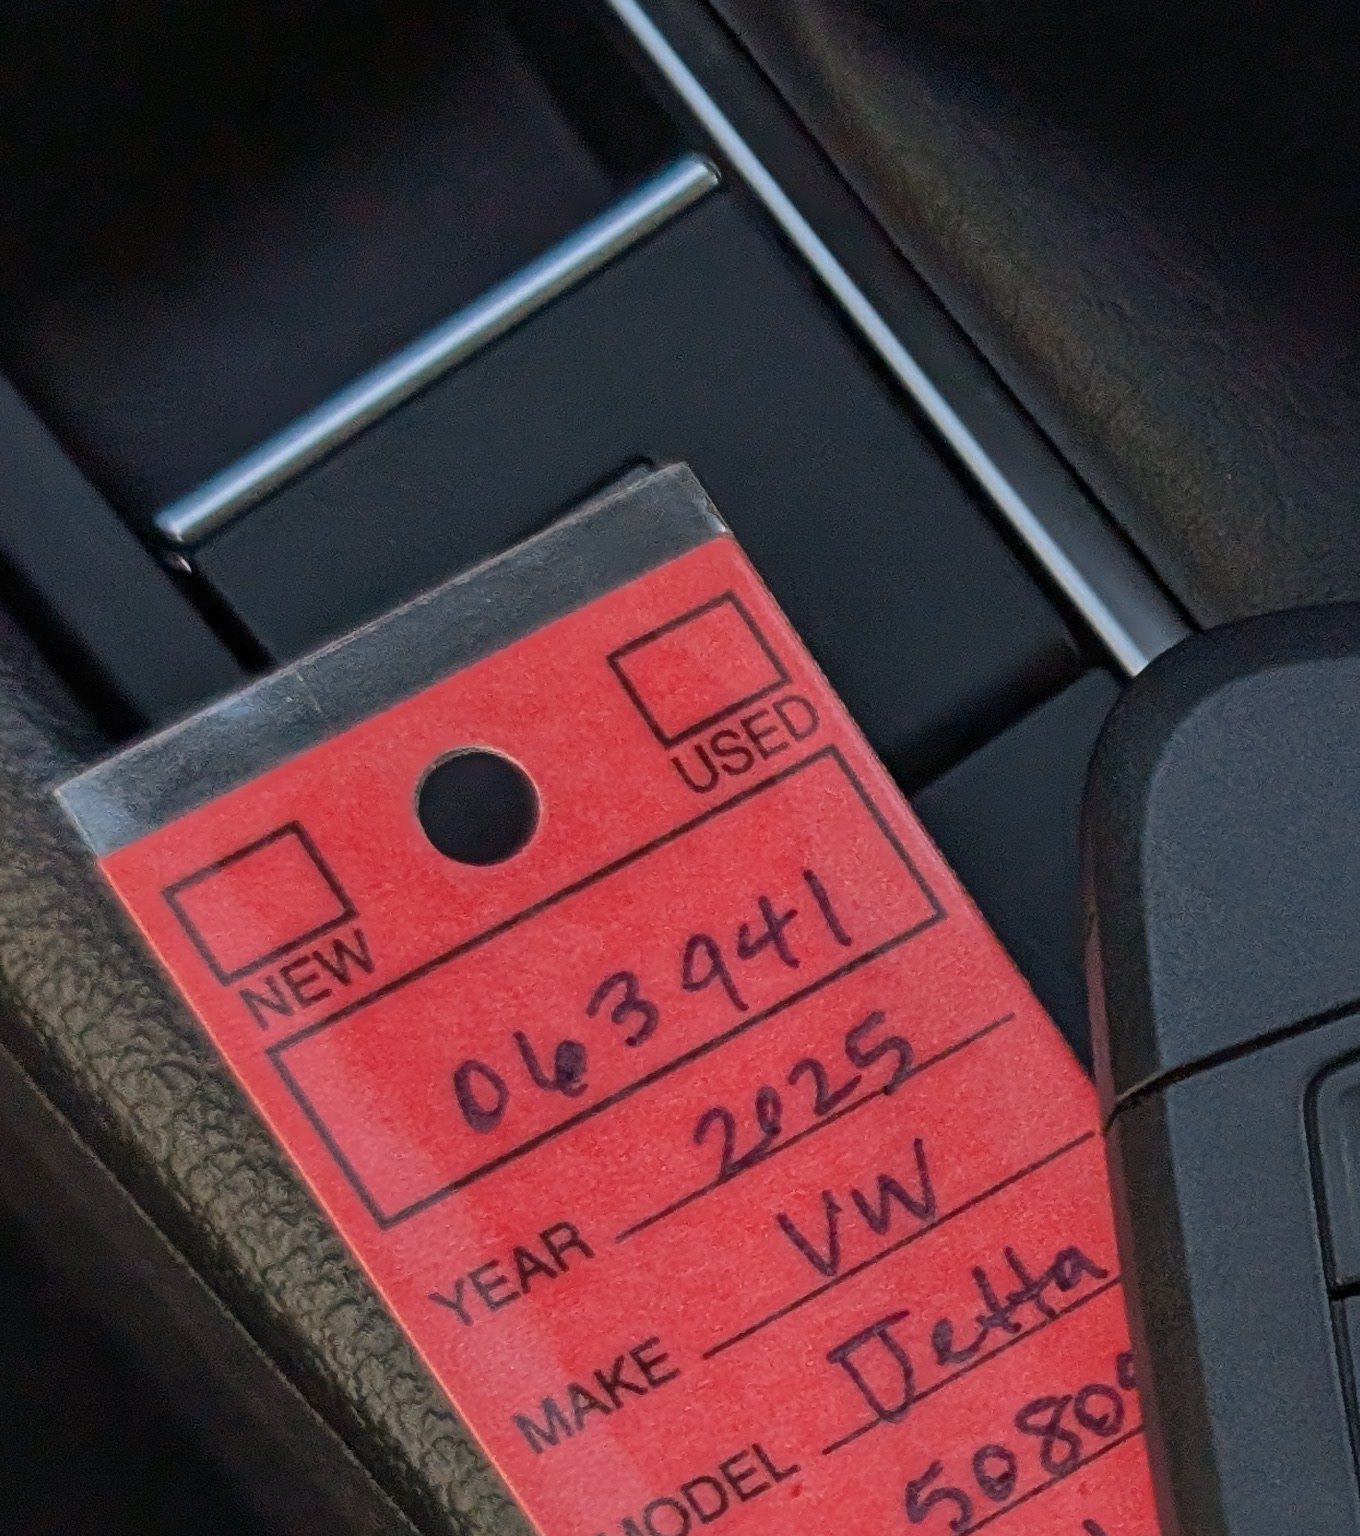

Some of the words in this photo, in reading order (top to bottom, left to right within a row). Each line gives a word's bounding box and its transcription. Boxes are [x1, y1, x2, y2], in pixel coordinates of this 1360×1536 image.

[672, 693, 822, 796] USED
[239, 929, 375, 1031] NEW
[453, 869, 852, 1133] 063941
[692, 1012, 915, 1181] 2025
[777, 1138, 935, 1277] VW
[429, 1222, 594, 1326] YEAR
[828, 1245, 1108, 1423] Jetta
[512, 1337, 681, 1455] MAKE
